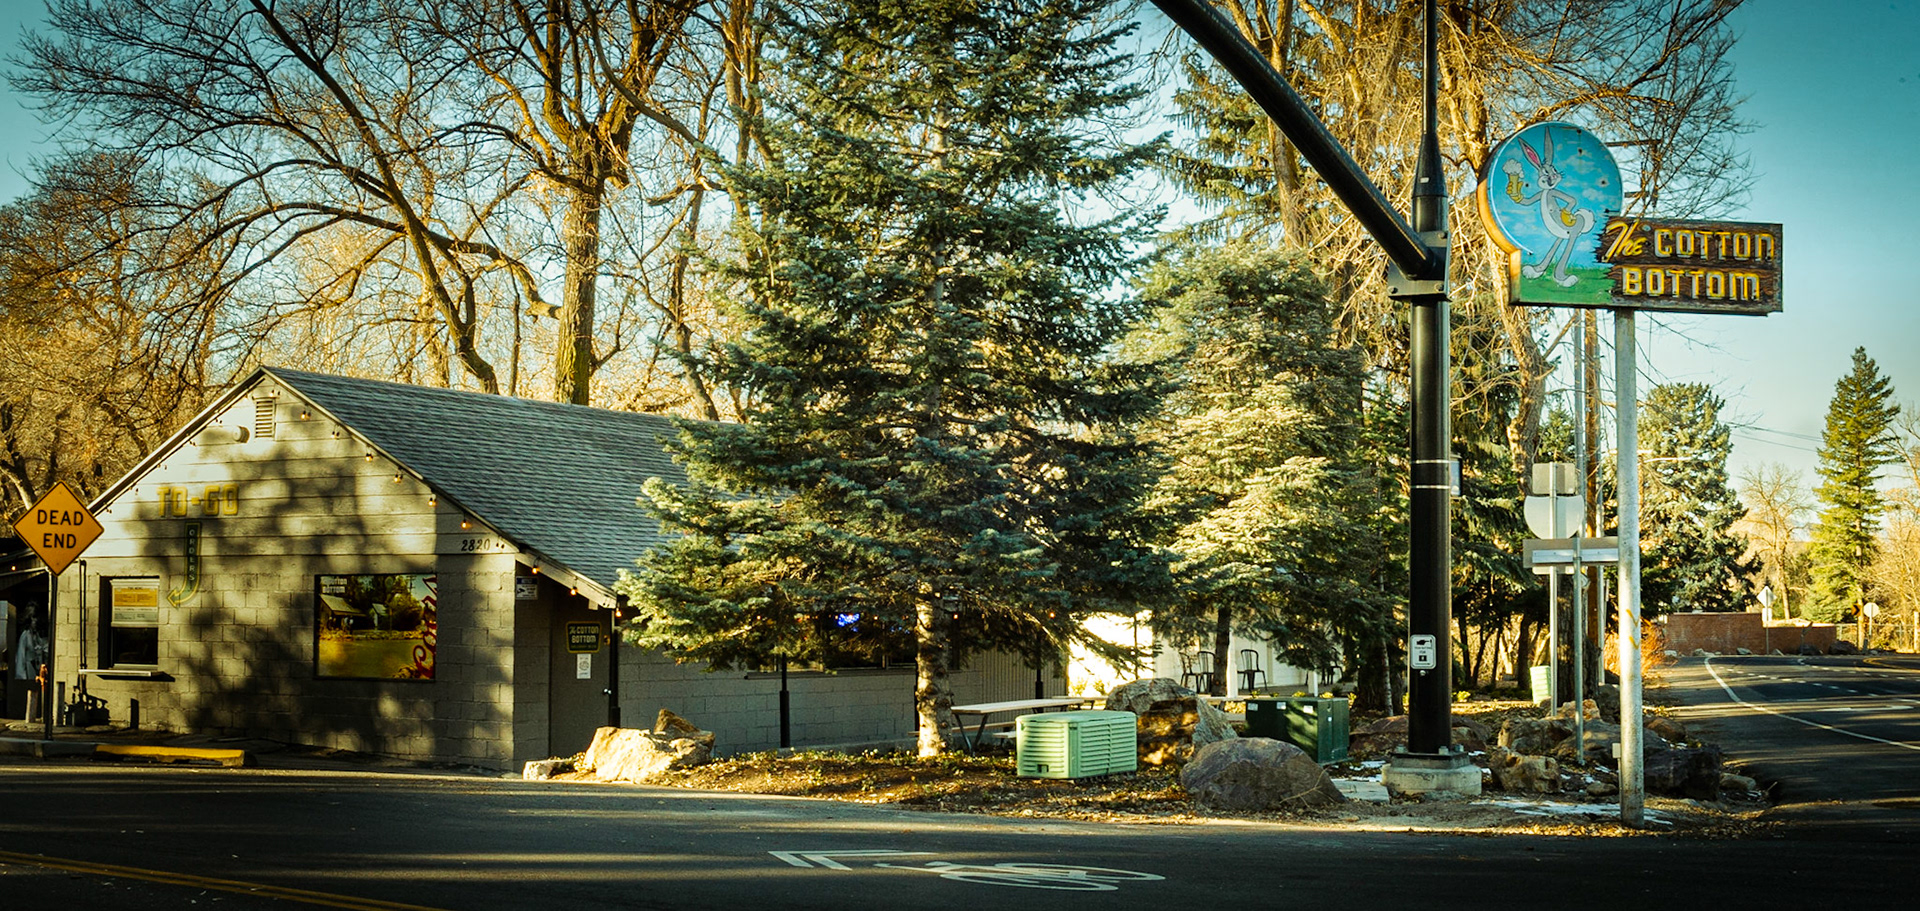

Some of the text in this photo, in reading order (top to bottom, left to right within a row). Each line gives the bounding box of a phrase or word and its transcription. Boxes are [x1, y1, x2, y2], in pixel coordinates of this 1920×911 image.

[1602, 218, 1775, 263] The COTTON
[1622, 266, 1760, 302] BOTTOM
[157, 483, 240, 517] TO-GO
[37, 509, 83, 527] DEAD
[42, 533, 77, 550] END
[461, 538, 491, 552] 2820
[188, 529, 196, 581] ORDERS
[571, 635, 597, 643] BOTTOM
